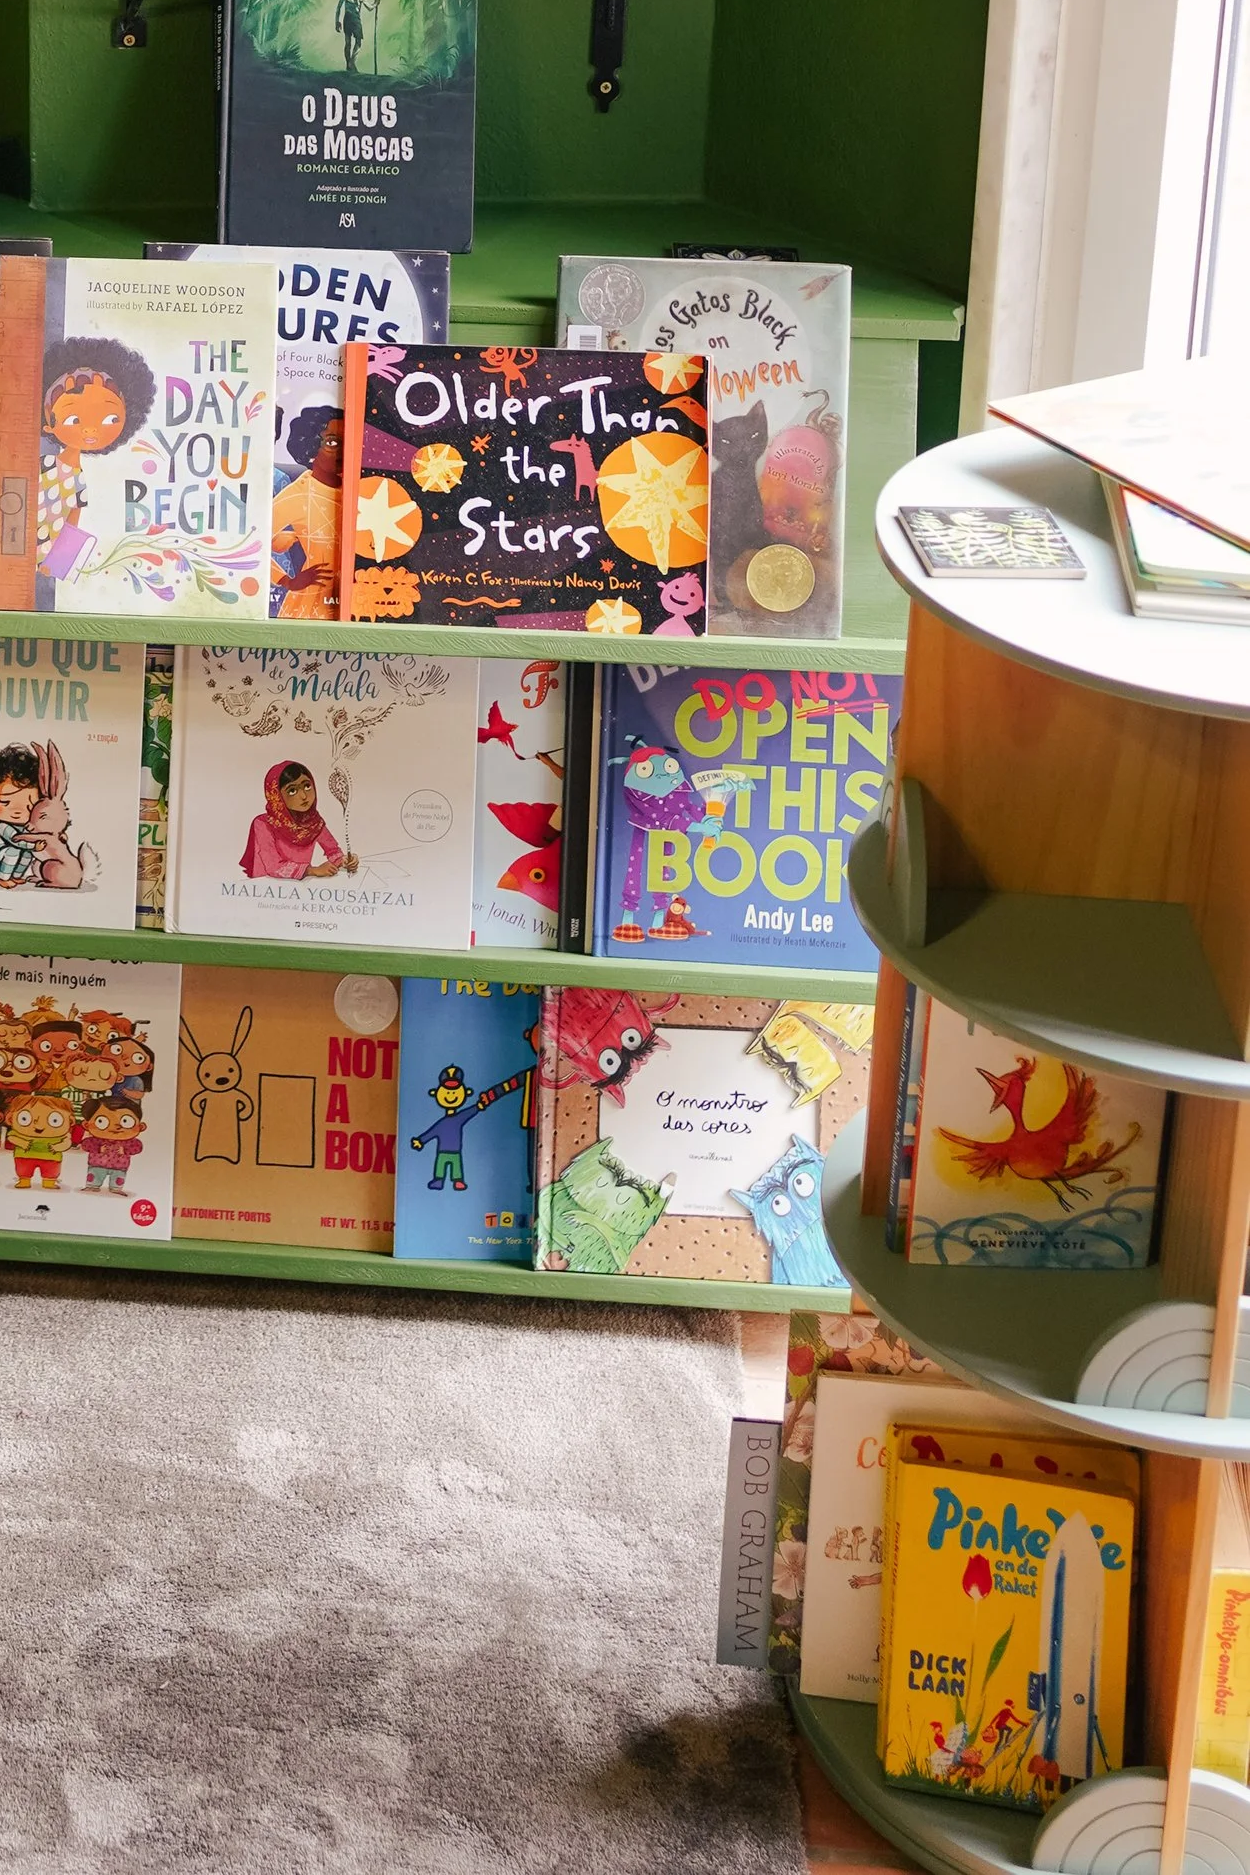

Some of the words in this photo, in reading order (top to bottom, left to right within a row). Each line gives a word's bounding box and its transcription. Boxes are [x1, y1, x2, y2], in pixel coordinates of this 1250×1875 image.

[302, 94, 315, 124] O
[324, 88, 397, 127] DEUS
[284, 134, 317, 155] DAS
[324, 129, 414, 161] MOSCAS
[297, 164, 349, 174] ROMANCE
[353, 162, 400, 176] GRÁFICO
[87, 282, 171, 295] JACQUELINE
[176, 285, 245, 297] WOODSON
[147, 300, 198, 313] RAFAEL
[202, 298, 243, 315] LÓPEZ
[669, 289, 732, 325] Gatos
[737, 289, 798, 352] Black
[188, 339, 248, 373] THE
[709, 334, 730, 349] on
[166, 376, 249, 427] DAY
[394, 372, 551, 425] Older
[559, 377, 678, 433] Than
[153, 429, 251, 482] YOU
[500, 446, 566, 487] the
[458, 496, 600, 558] Stars
[421, 570, 462, 584] Karen
[466, 572, 479, 584] C.
[482, 571, 501, 585] Fox
[565, 573, 605, 590] Nancy
[609, 574, 641, 590] Davis
[290, 670, 380, 701] Malala
[674, 693, 888, 766] OPEN
[722, 763, 882, 834] THIS
[221, 882, 302, 901] MALALA
[307, 887, 414, 906] YOUSAFZAI
[302, 901, 378, 916] KERASCOËT
[744, 904, 796, 934] Andy
[801, 907, 834, 933] Lee
[326, 1036, 399, 1081] NOT
[325, 1084, 350, 1124] A
[656, 1091, 674, 1109] O
[677, 1095, 769, 1114] monstro
[663, 1114, 695, 1133] das
[701, 1118, 752, 1136] cores
[325, 1129, 396, 1173] BOX
[181, 1207, 235, 1222] ANTOINETTE
[238, 1210, 271, 1223] PORTIS
[743, 1434, 772, 1496] BOB
[734, 1509, 769, 1652] GRAHAM
[995, 1560, 1015, 1576] en
[1017, 1562, 1037, 1577] de
[994, 1576, 1037, 1597] Raket
[910, 1650, 966, 1675] DICK
[908, 1671, 965, 1697] LAAN
